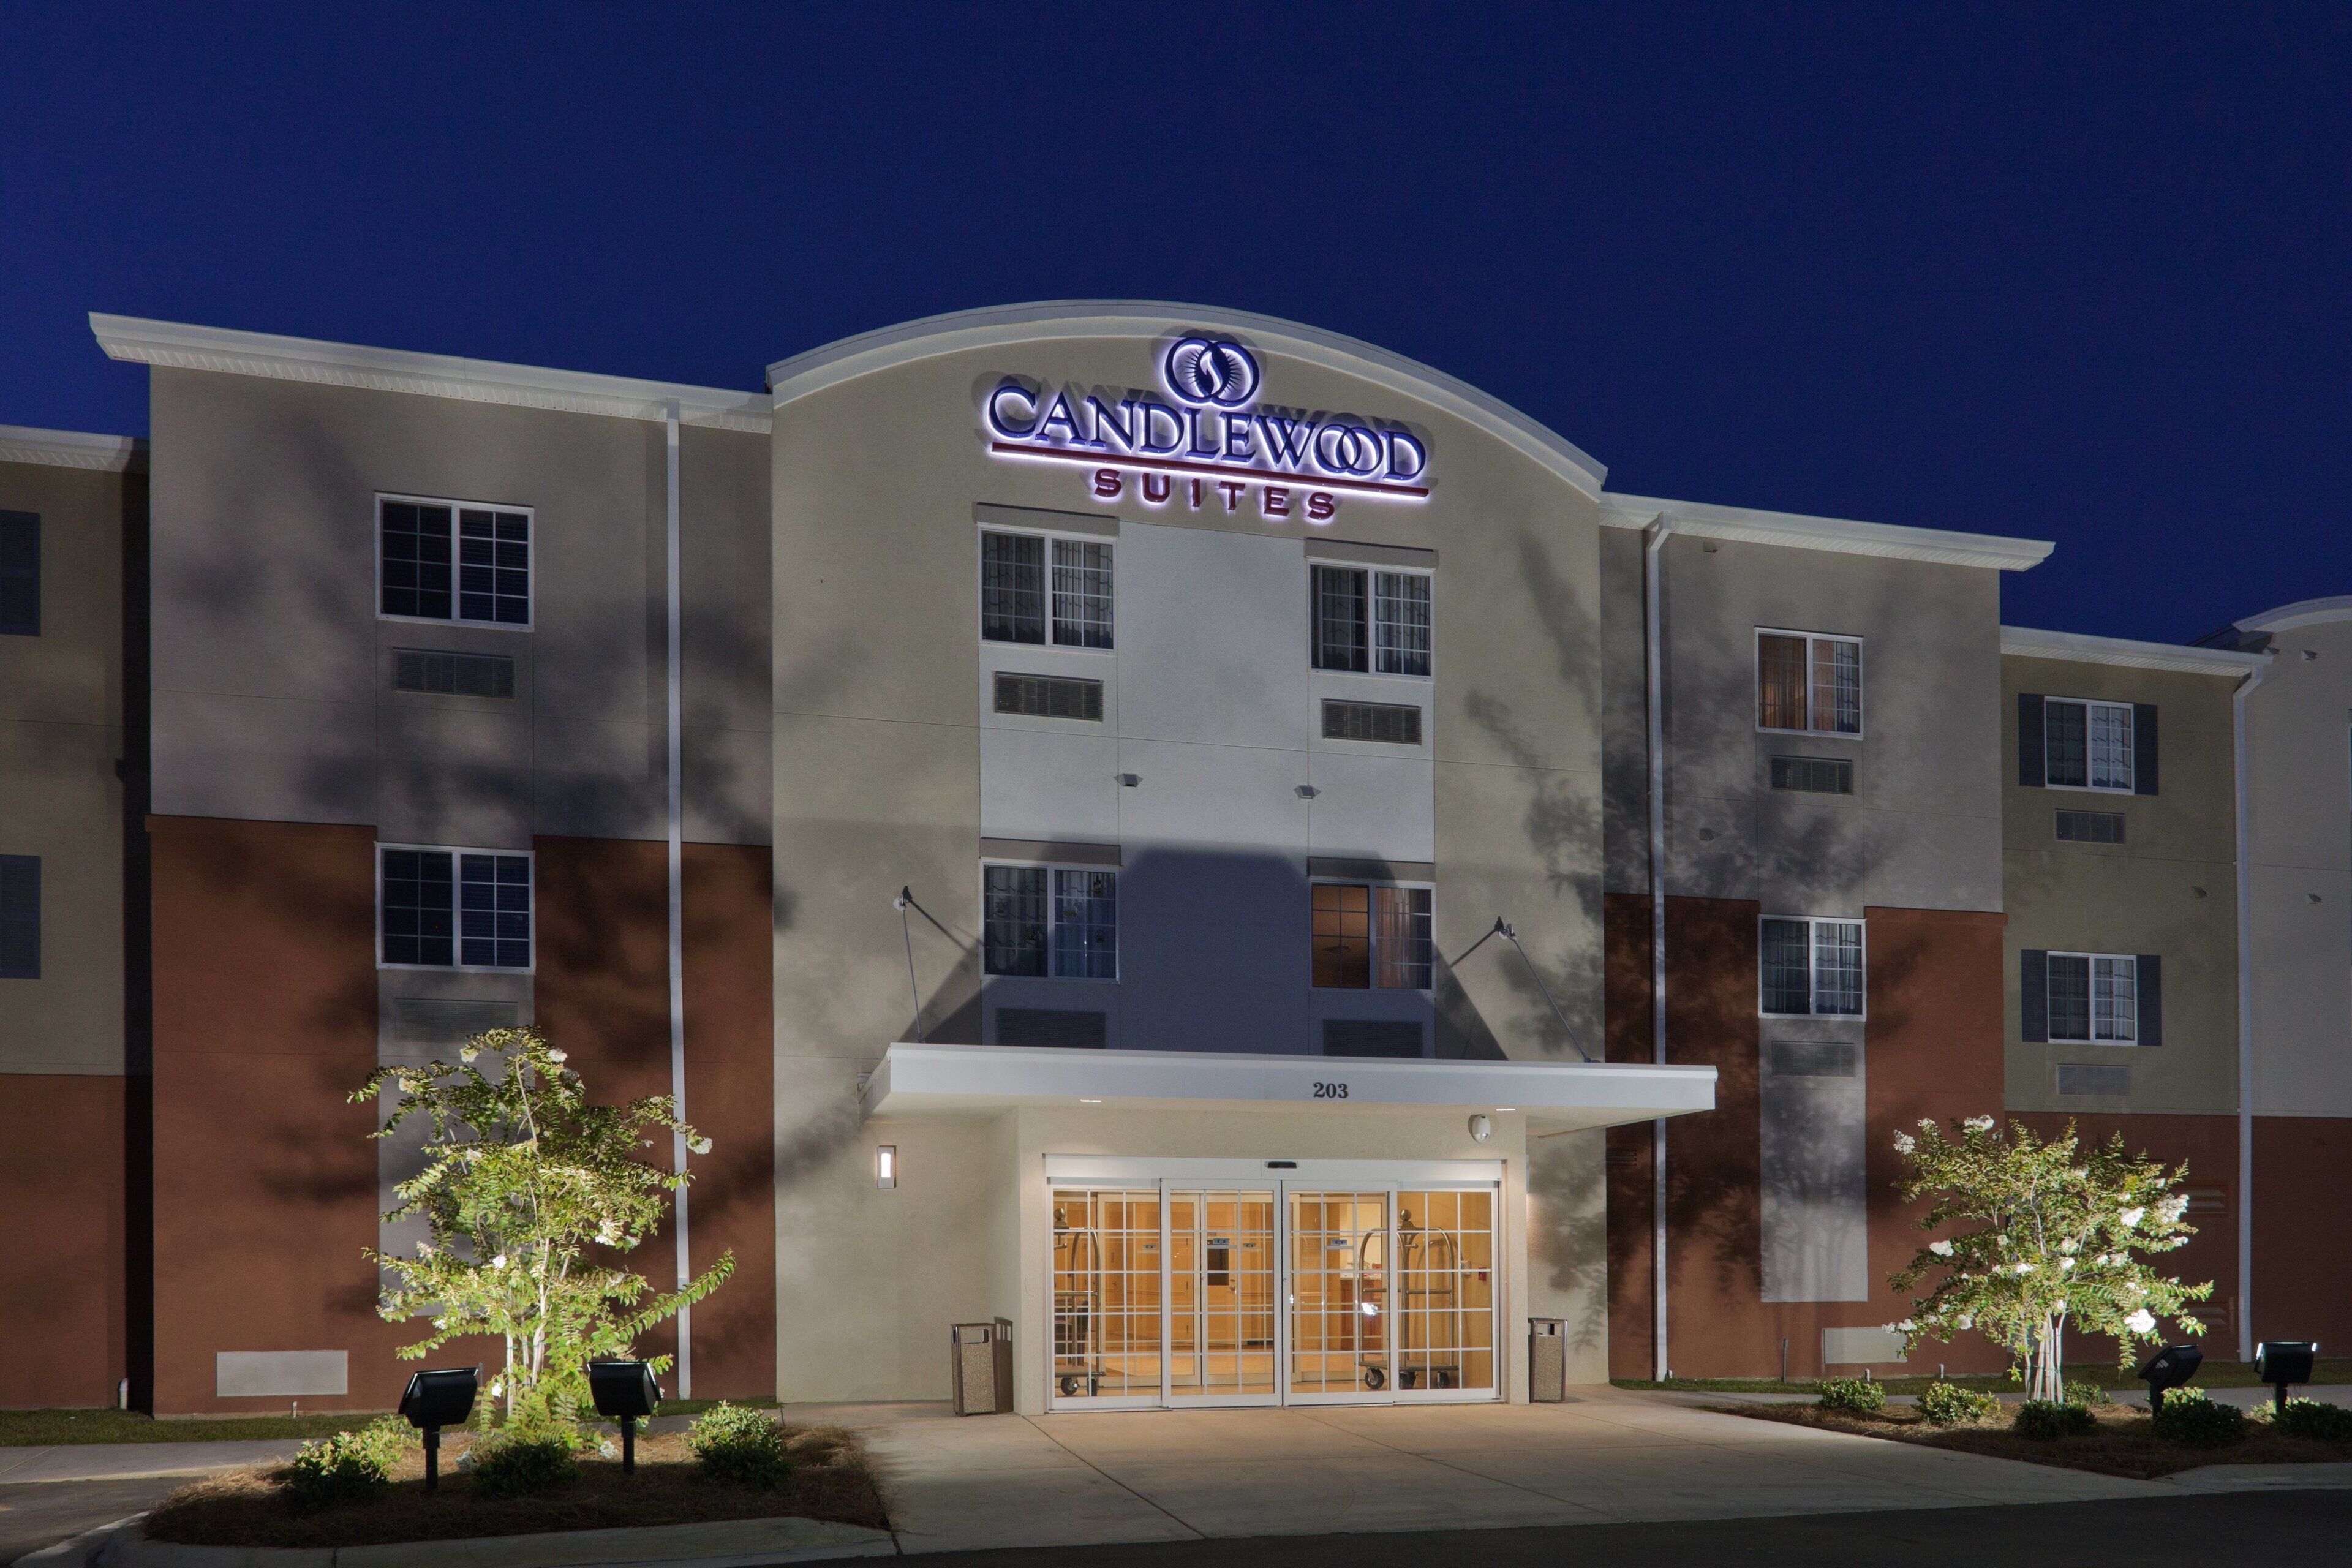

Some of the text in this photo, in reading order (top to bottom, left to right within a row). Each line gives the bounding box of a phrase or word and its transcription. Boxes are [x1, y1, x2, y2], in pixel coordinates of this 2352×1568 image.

[988, 385, 1427, 481] CANDLEWOOD
[1094, 468, 1335, 520] SUITES
[1313, 1082, 1349, 1098] 203
